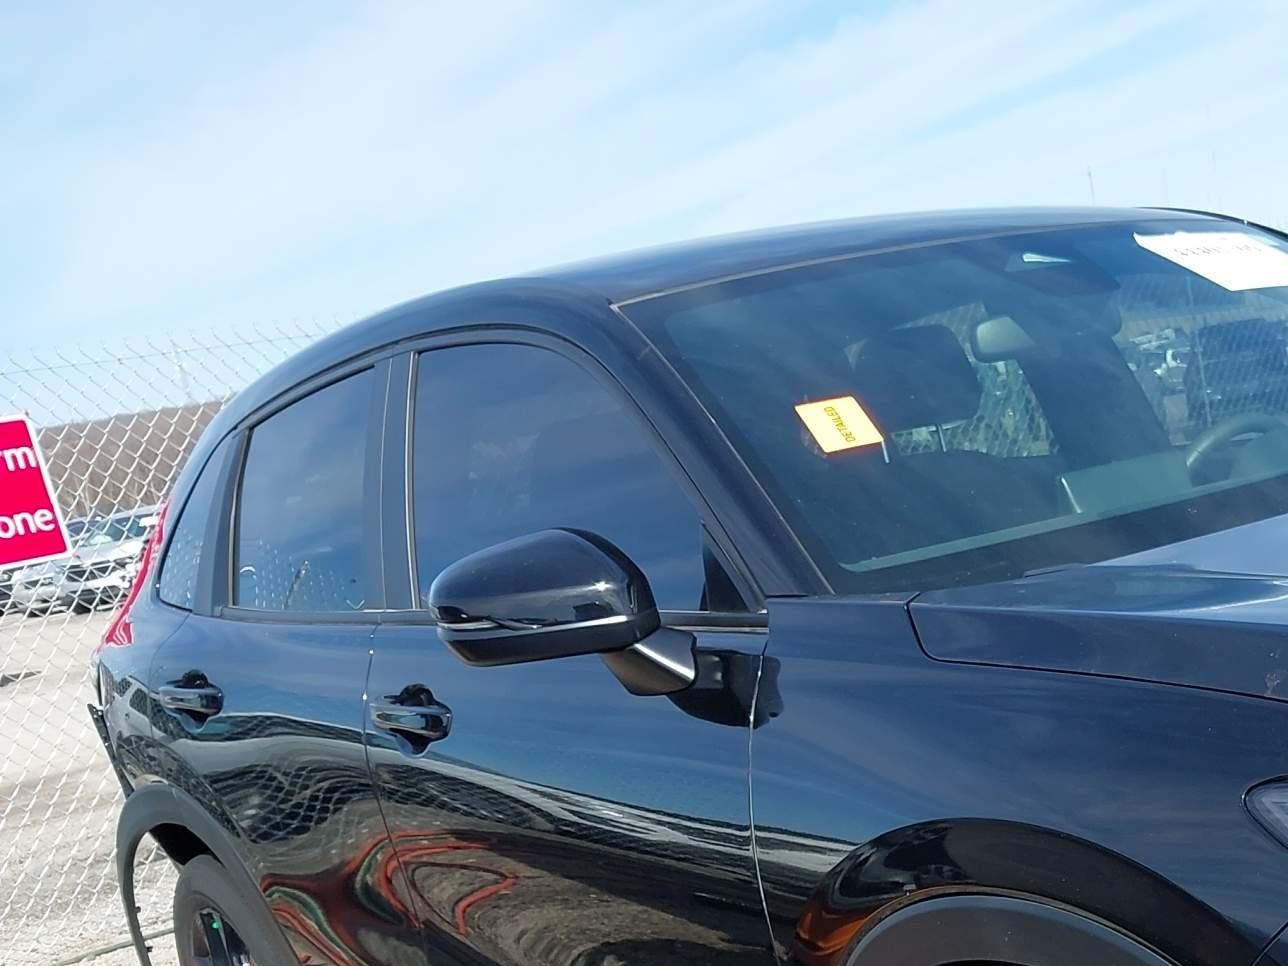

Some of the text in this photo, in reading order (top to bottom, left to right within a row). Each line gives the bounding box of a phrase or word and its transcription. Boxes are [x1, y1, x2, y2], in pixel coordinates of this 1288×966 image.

[823, 406, 857, 443] DETAILED
[0, 446, 38, 472] m
[0, 508, 56, 539] one
